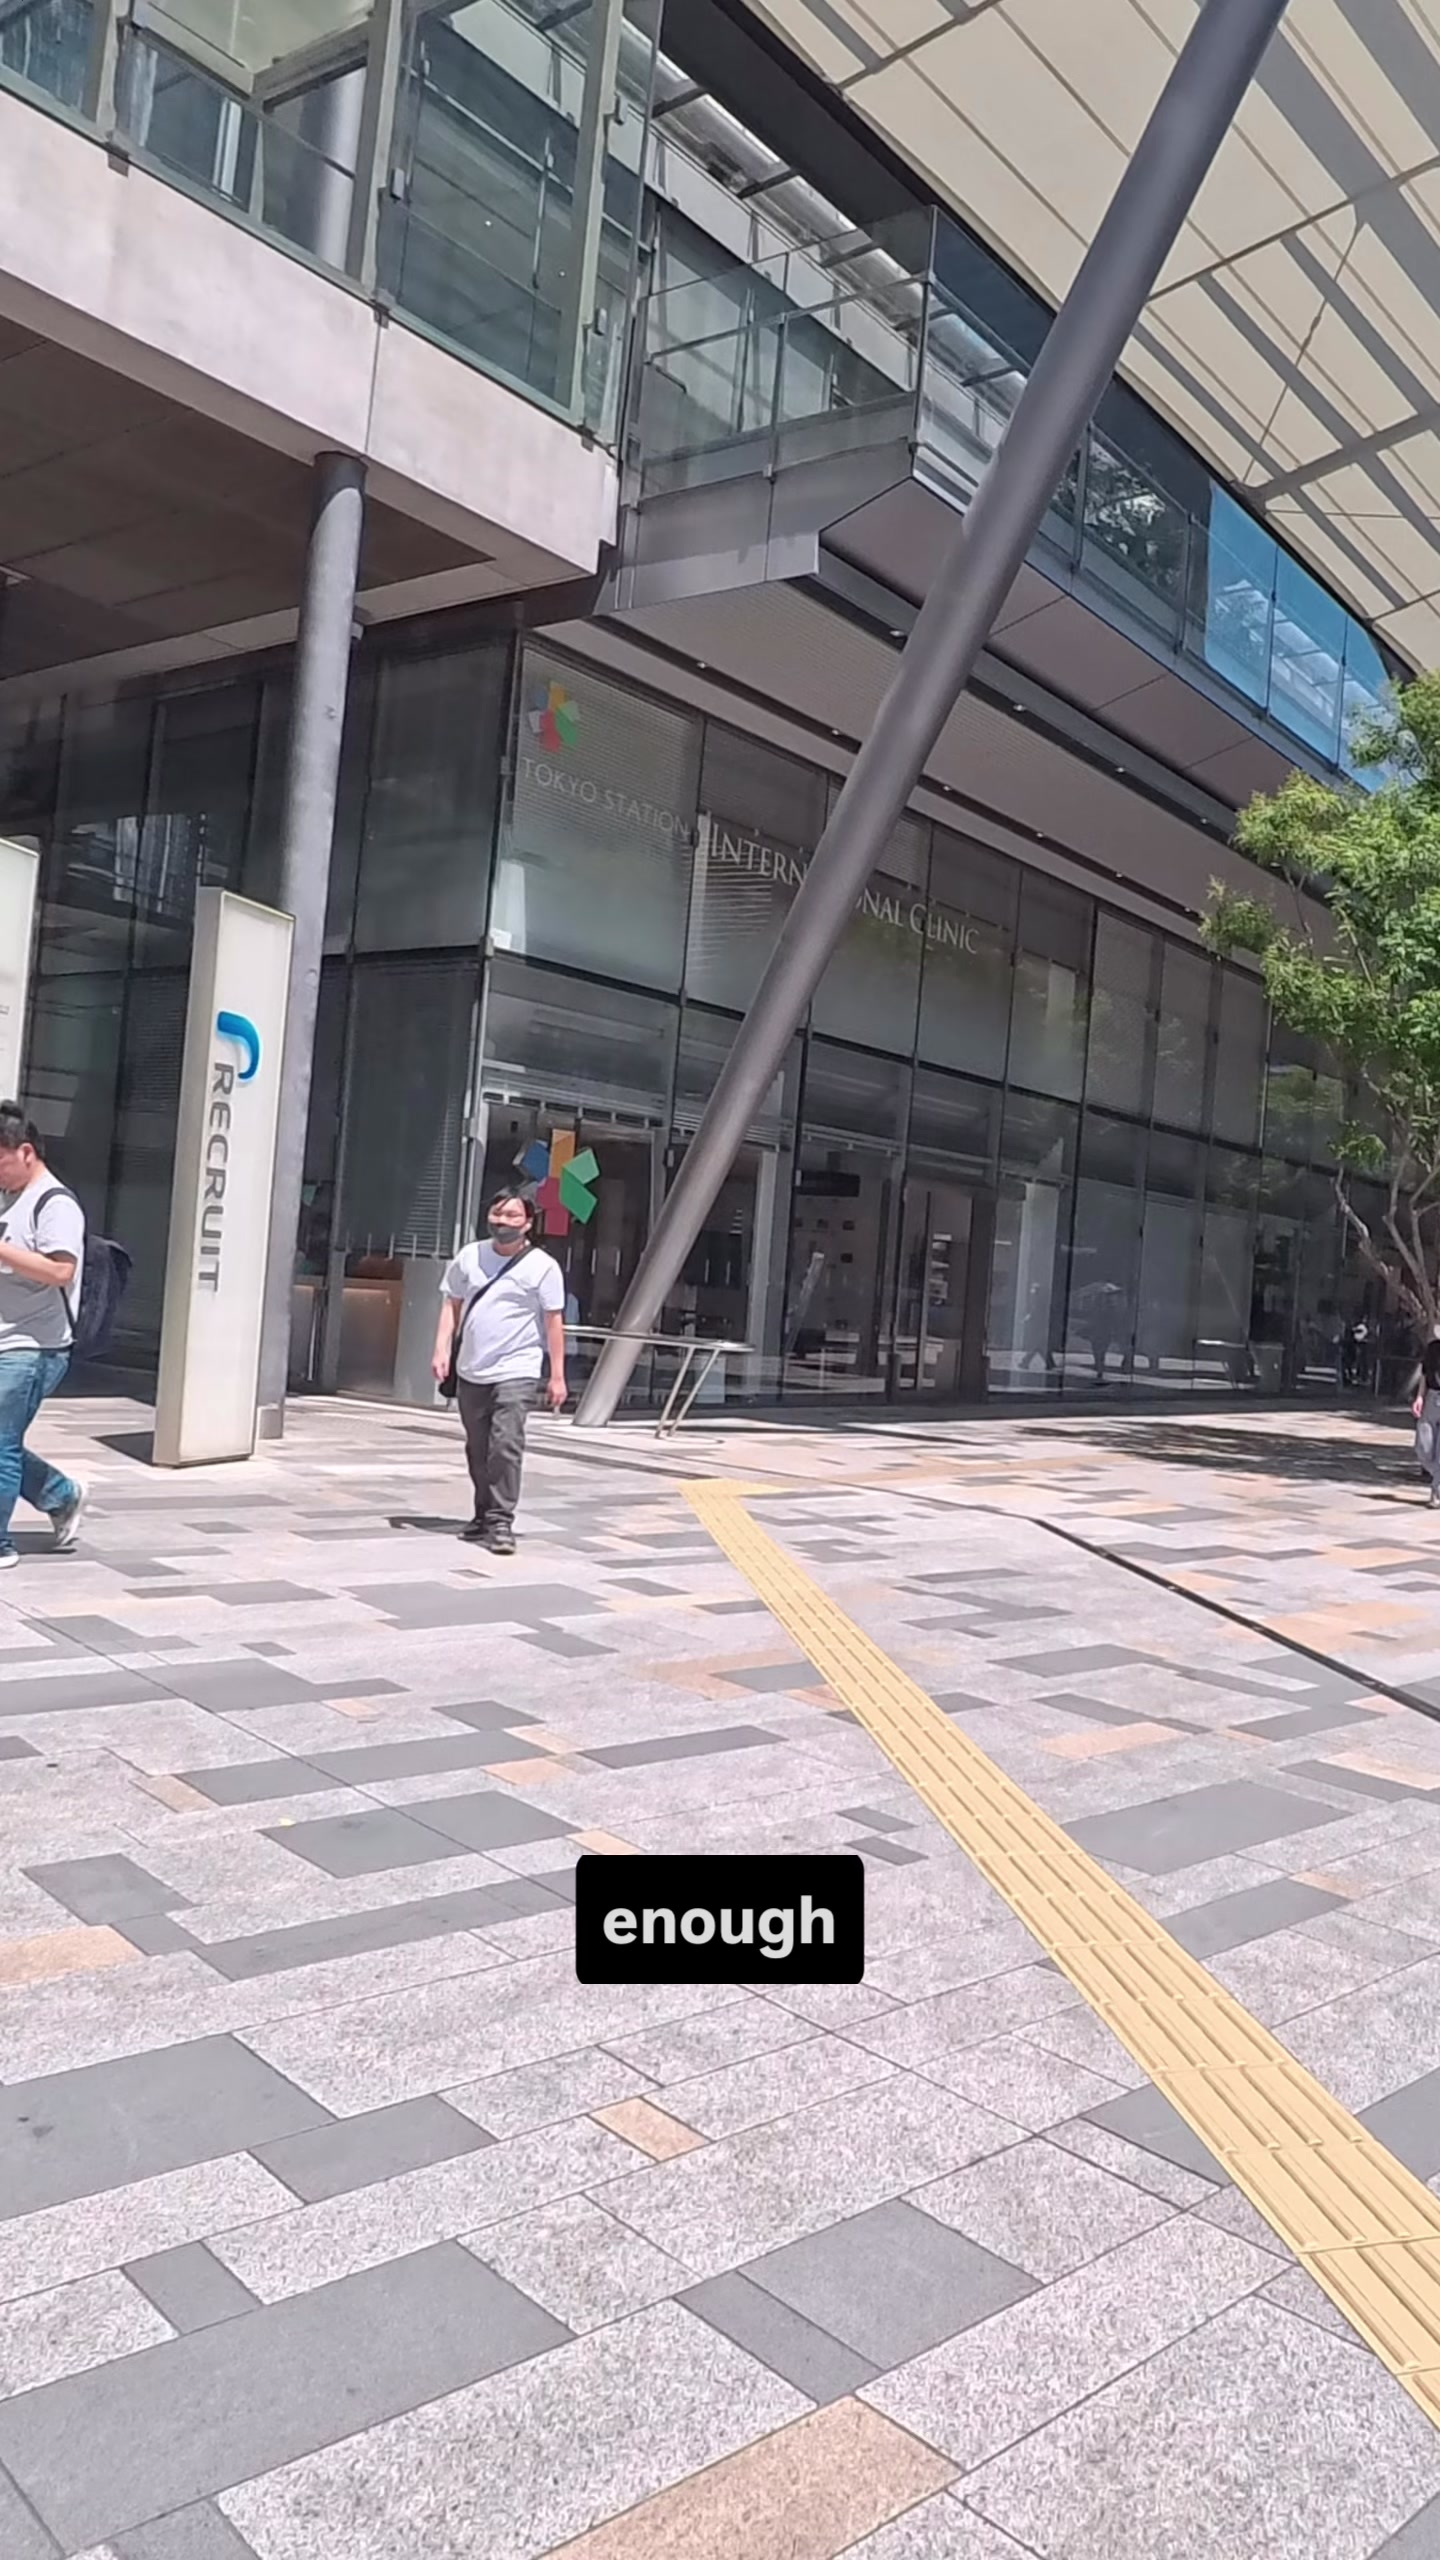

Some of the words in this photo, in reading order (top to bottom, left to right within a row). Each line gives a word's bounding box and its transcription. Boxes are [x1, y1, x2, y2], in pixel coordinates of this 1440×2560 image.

[522, 756, 597, 803] TOKYO
[604, 789, 690, 839] STATION
[711, 822, 904, 928] INTERNNAL
[909, 903, 980, 955] CLINIC
[198, 1062, 234, 1292] RECRUIT
